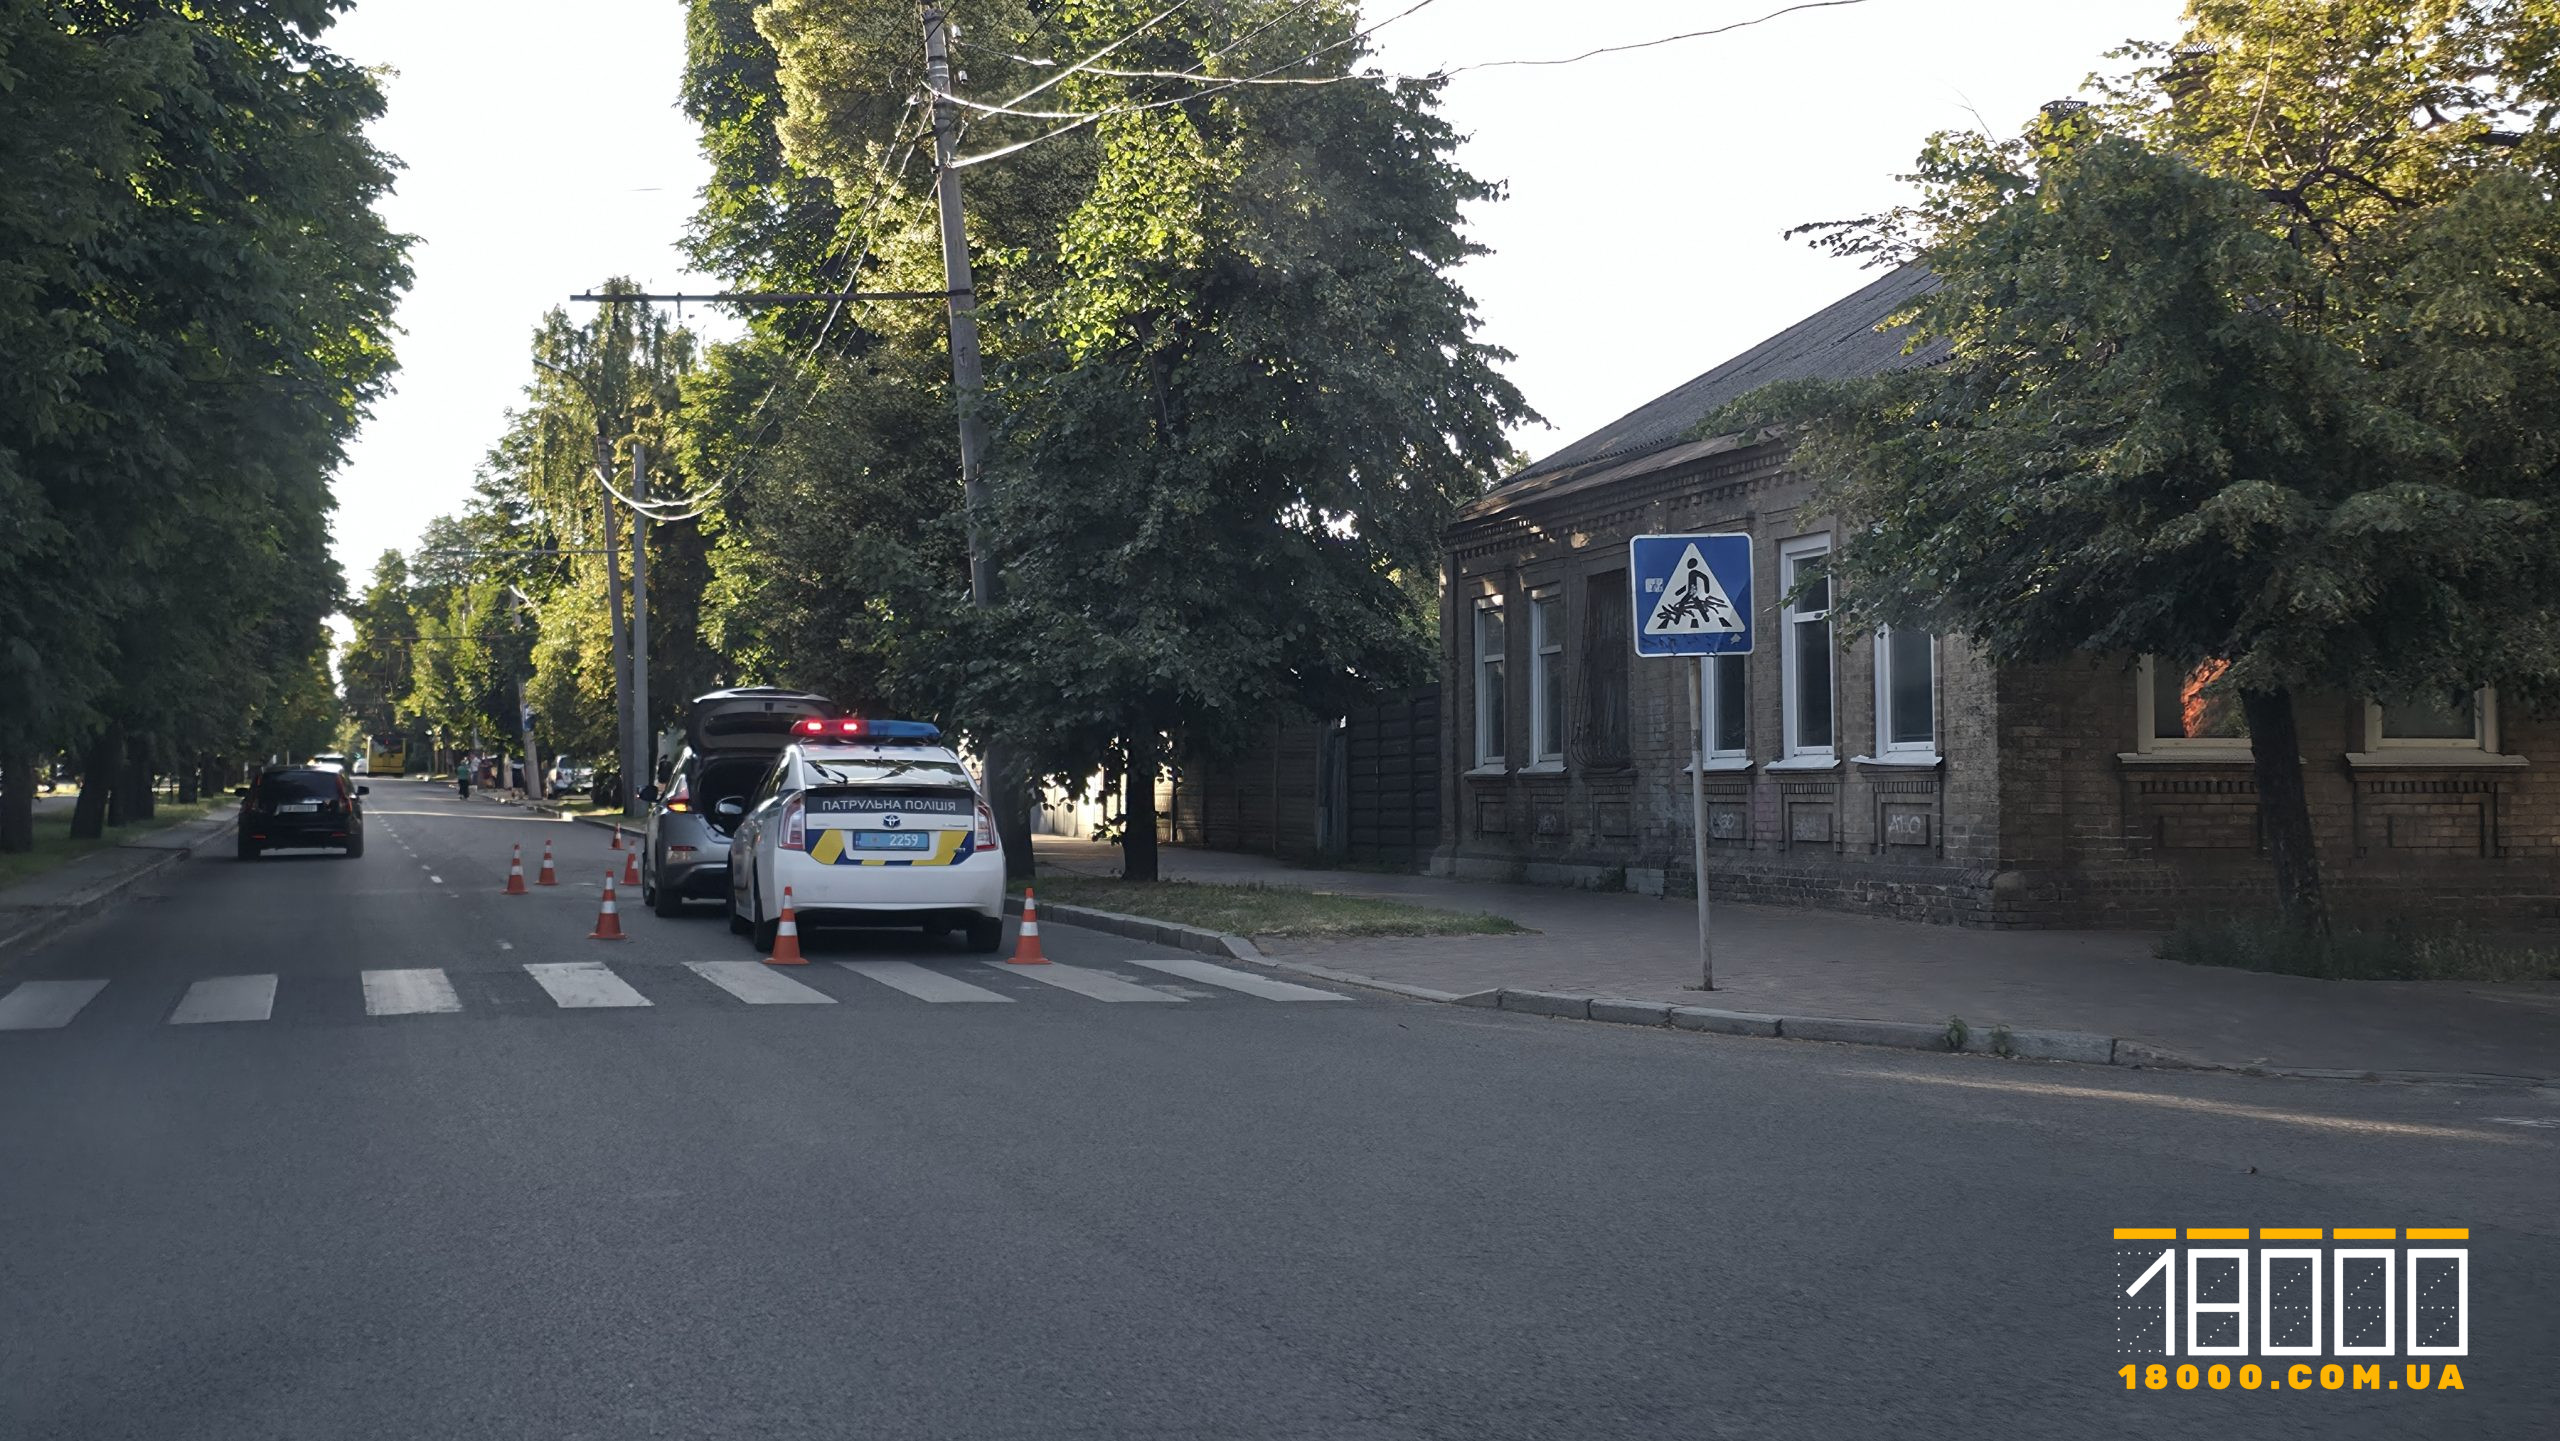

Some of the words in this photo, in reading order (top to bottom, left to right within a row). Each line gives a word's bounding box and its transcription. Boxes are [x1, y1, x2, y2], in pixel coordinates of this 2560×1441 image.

[822, 799, 902, 811] ПАТРУЛЬНА
[904, 799, 956, 812] ПОЛІЦІЯ
[889, 834, 919, 847] 2259
